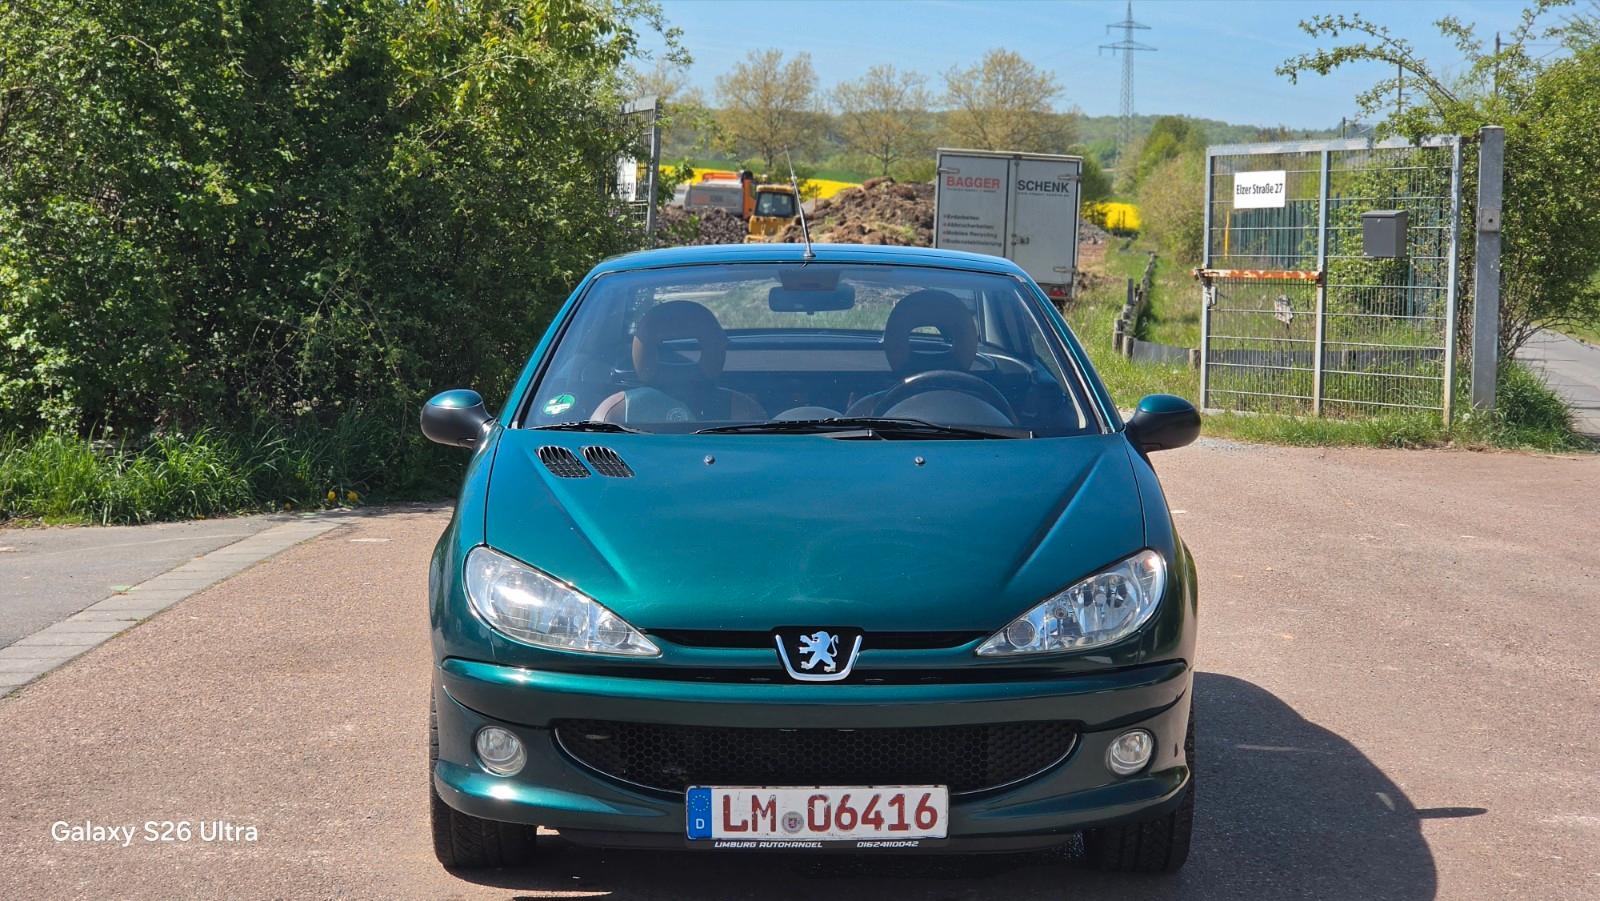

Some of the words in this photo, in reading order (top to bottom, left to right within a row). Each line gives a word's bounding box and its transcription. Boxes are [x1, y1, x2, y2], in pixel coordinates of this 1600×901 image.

[946, 176, 1000, 189] BAGGER
[1017, 180, 1069, 193] SCHENK
[1236, 184, 1251, 195] Elzer
[1252, 183, 1274, 195] Straße
[1274, 183, 1283, 194] 27
[696, 818, 704, 829] D
[722, 794, 777, 832] LM
[807, 793, 938, 832] 06416
